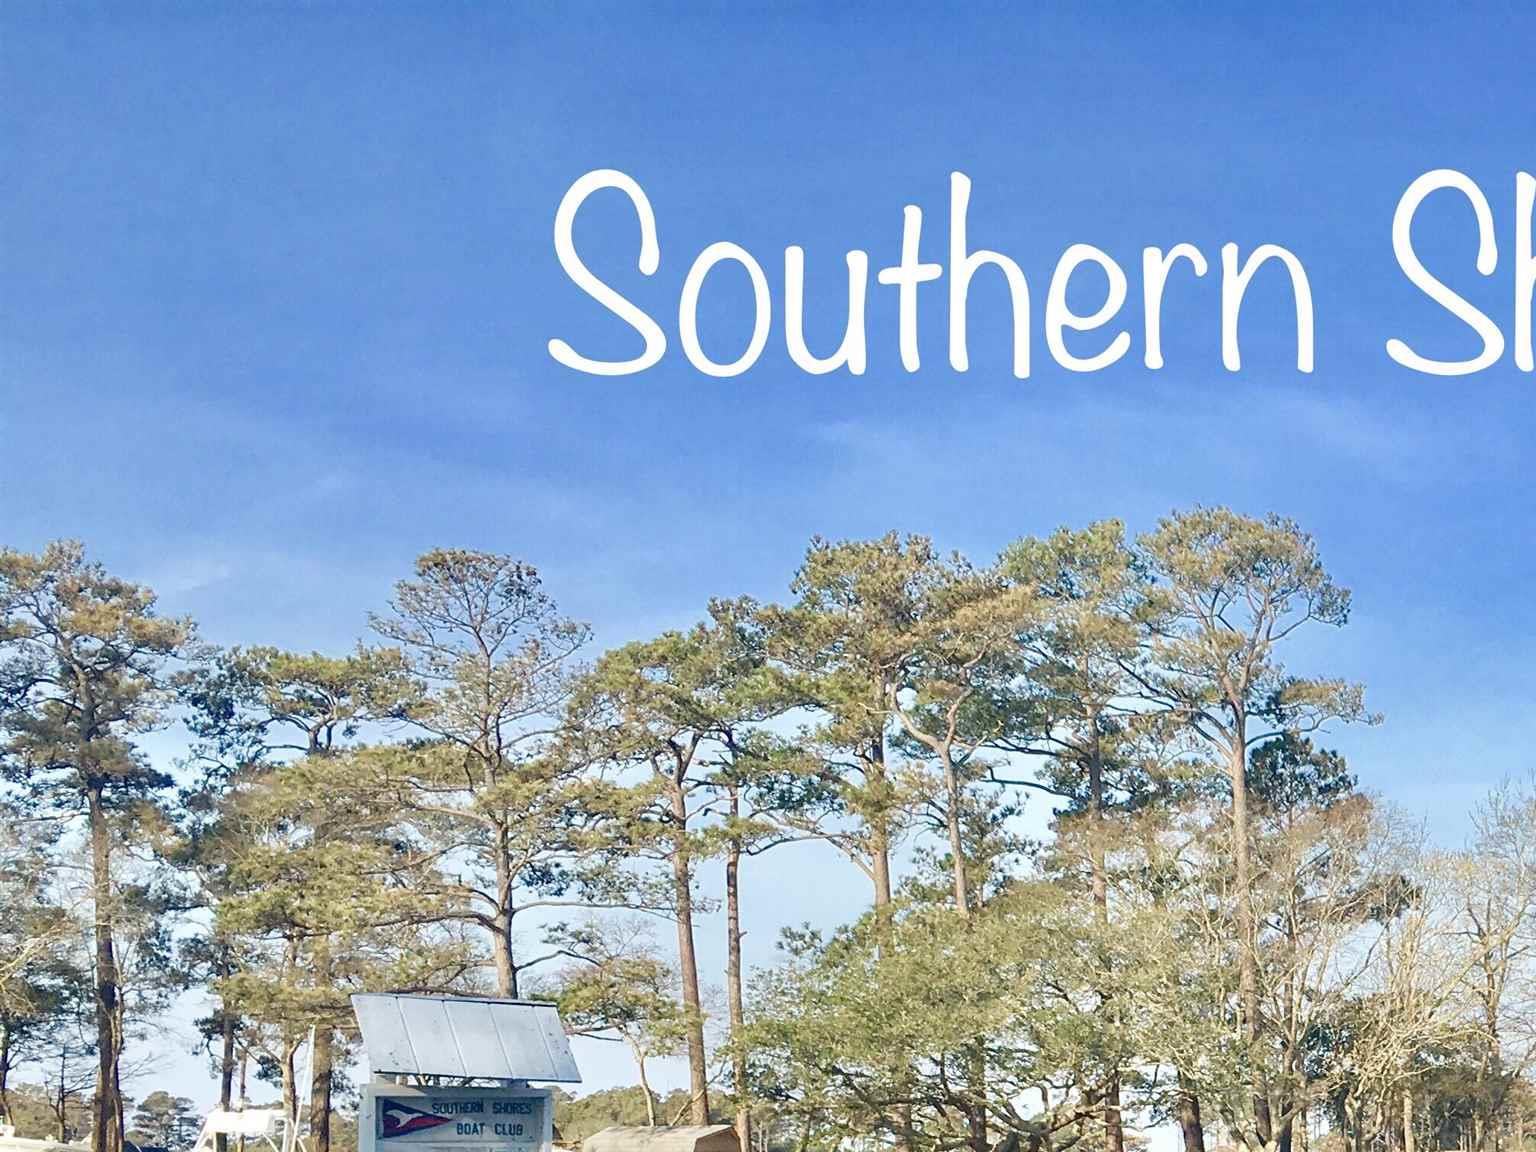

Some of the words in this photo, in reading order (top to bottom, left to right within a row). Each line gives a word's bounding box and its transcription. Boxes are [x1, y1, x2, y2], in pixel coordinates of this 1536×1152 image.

[432, 1102, 484, 1114] SOUTHERN
[492, 1102, 532, 1114] SHORES
[456, 1123, 485, 1136] BOAT
[494, 1123, 524, 1136] CLUB
